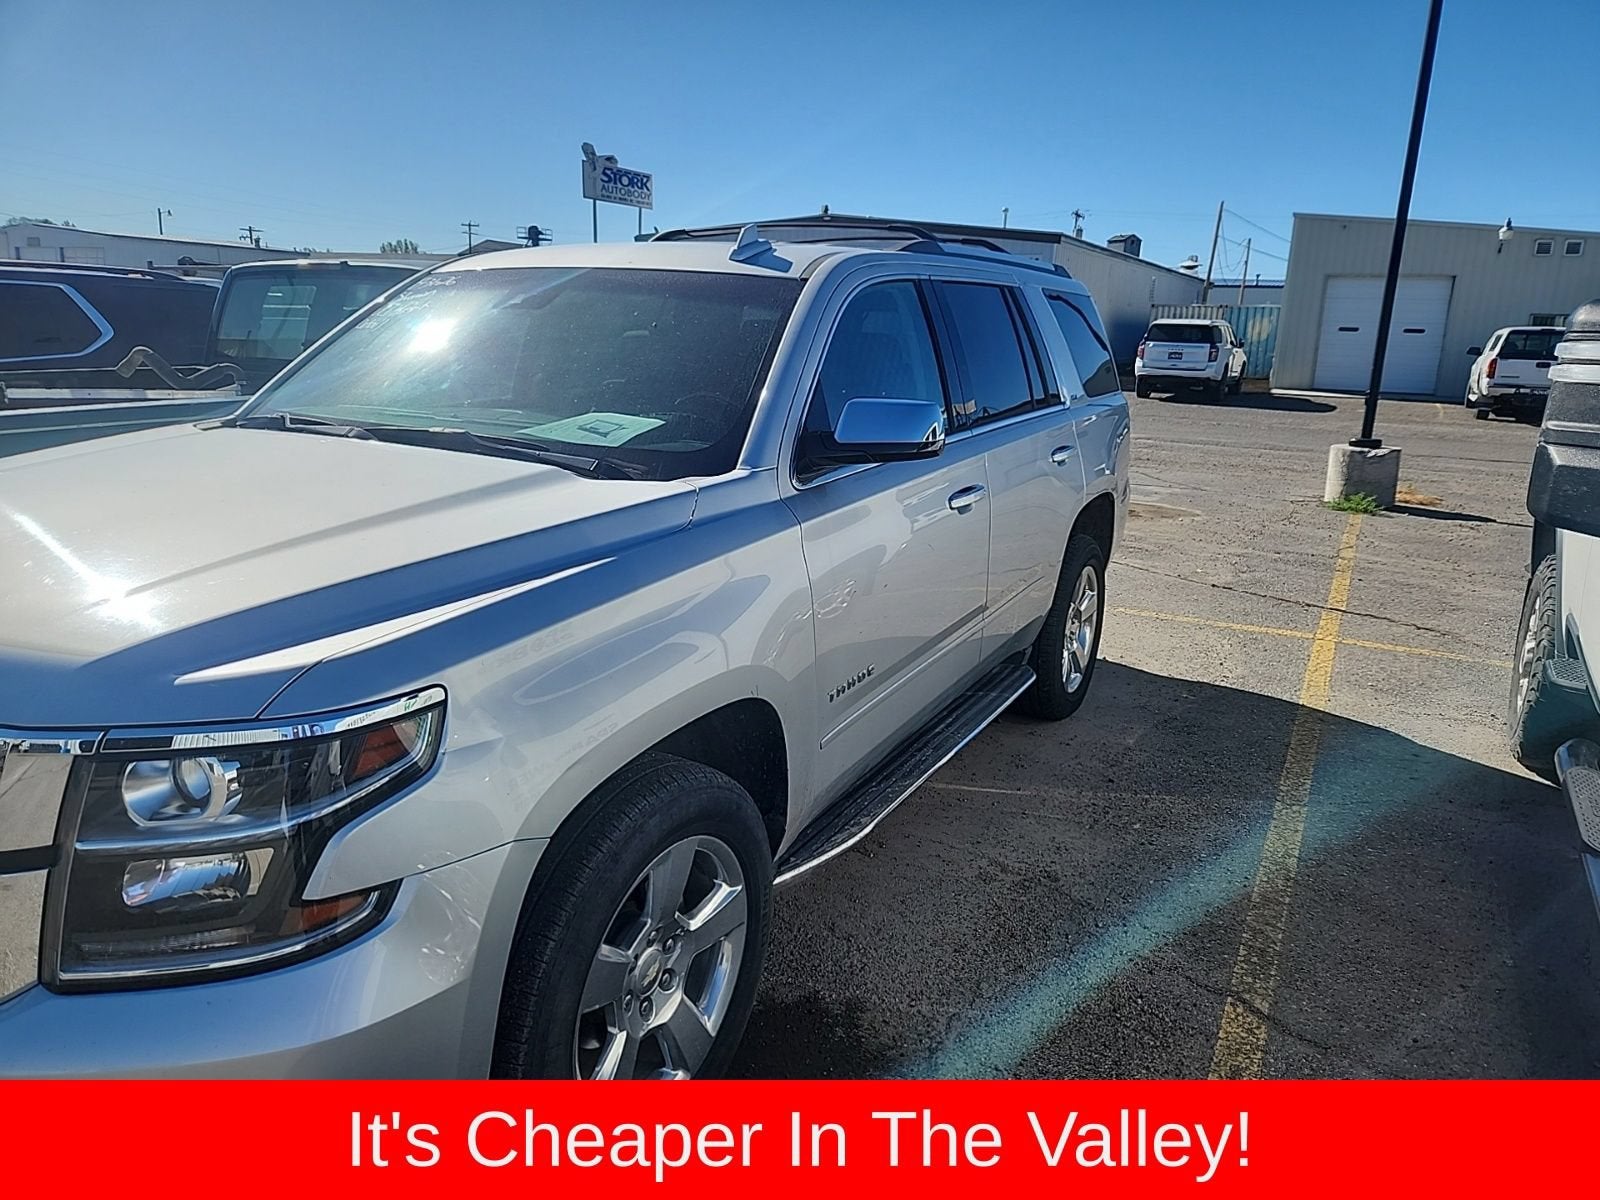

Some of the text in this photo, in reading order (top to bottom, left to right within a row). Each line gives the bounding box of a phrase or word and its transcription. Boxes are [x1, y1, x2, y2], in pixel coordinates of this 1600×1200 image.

[600, 167, 651, 192] STORK
[600, 184, 652, 201] AUTOBODY
[827, 663, 875, 703] TAHOE
